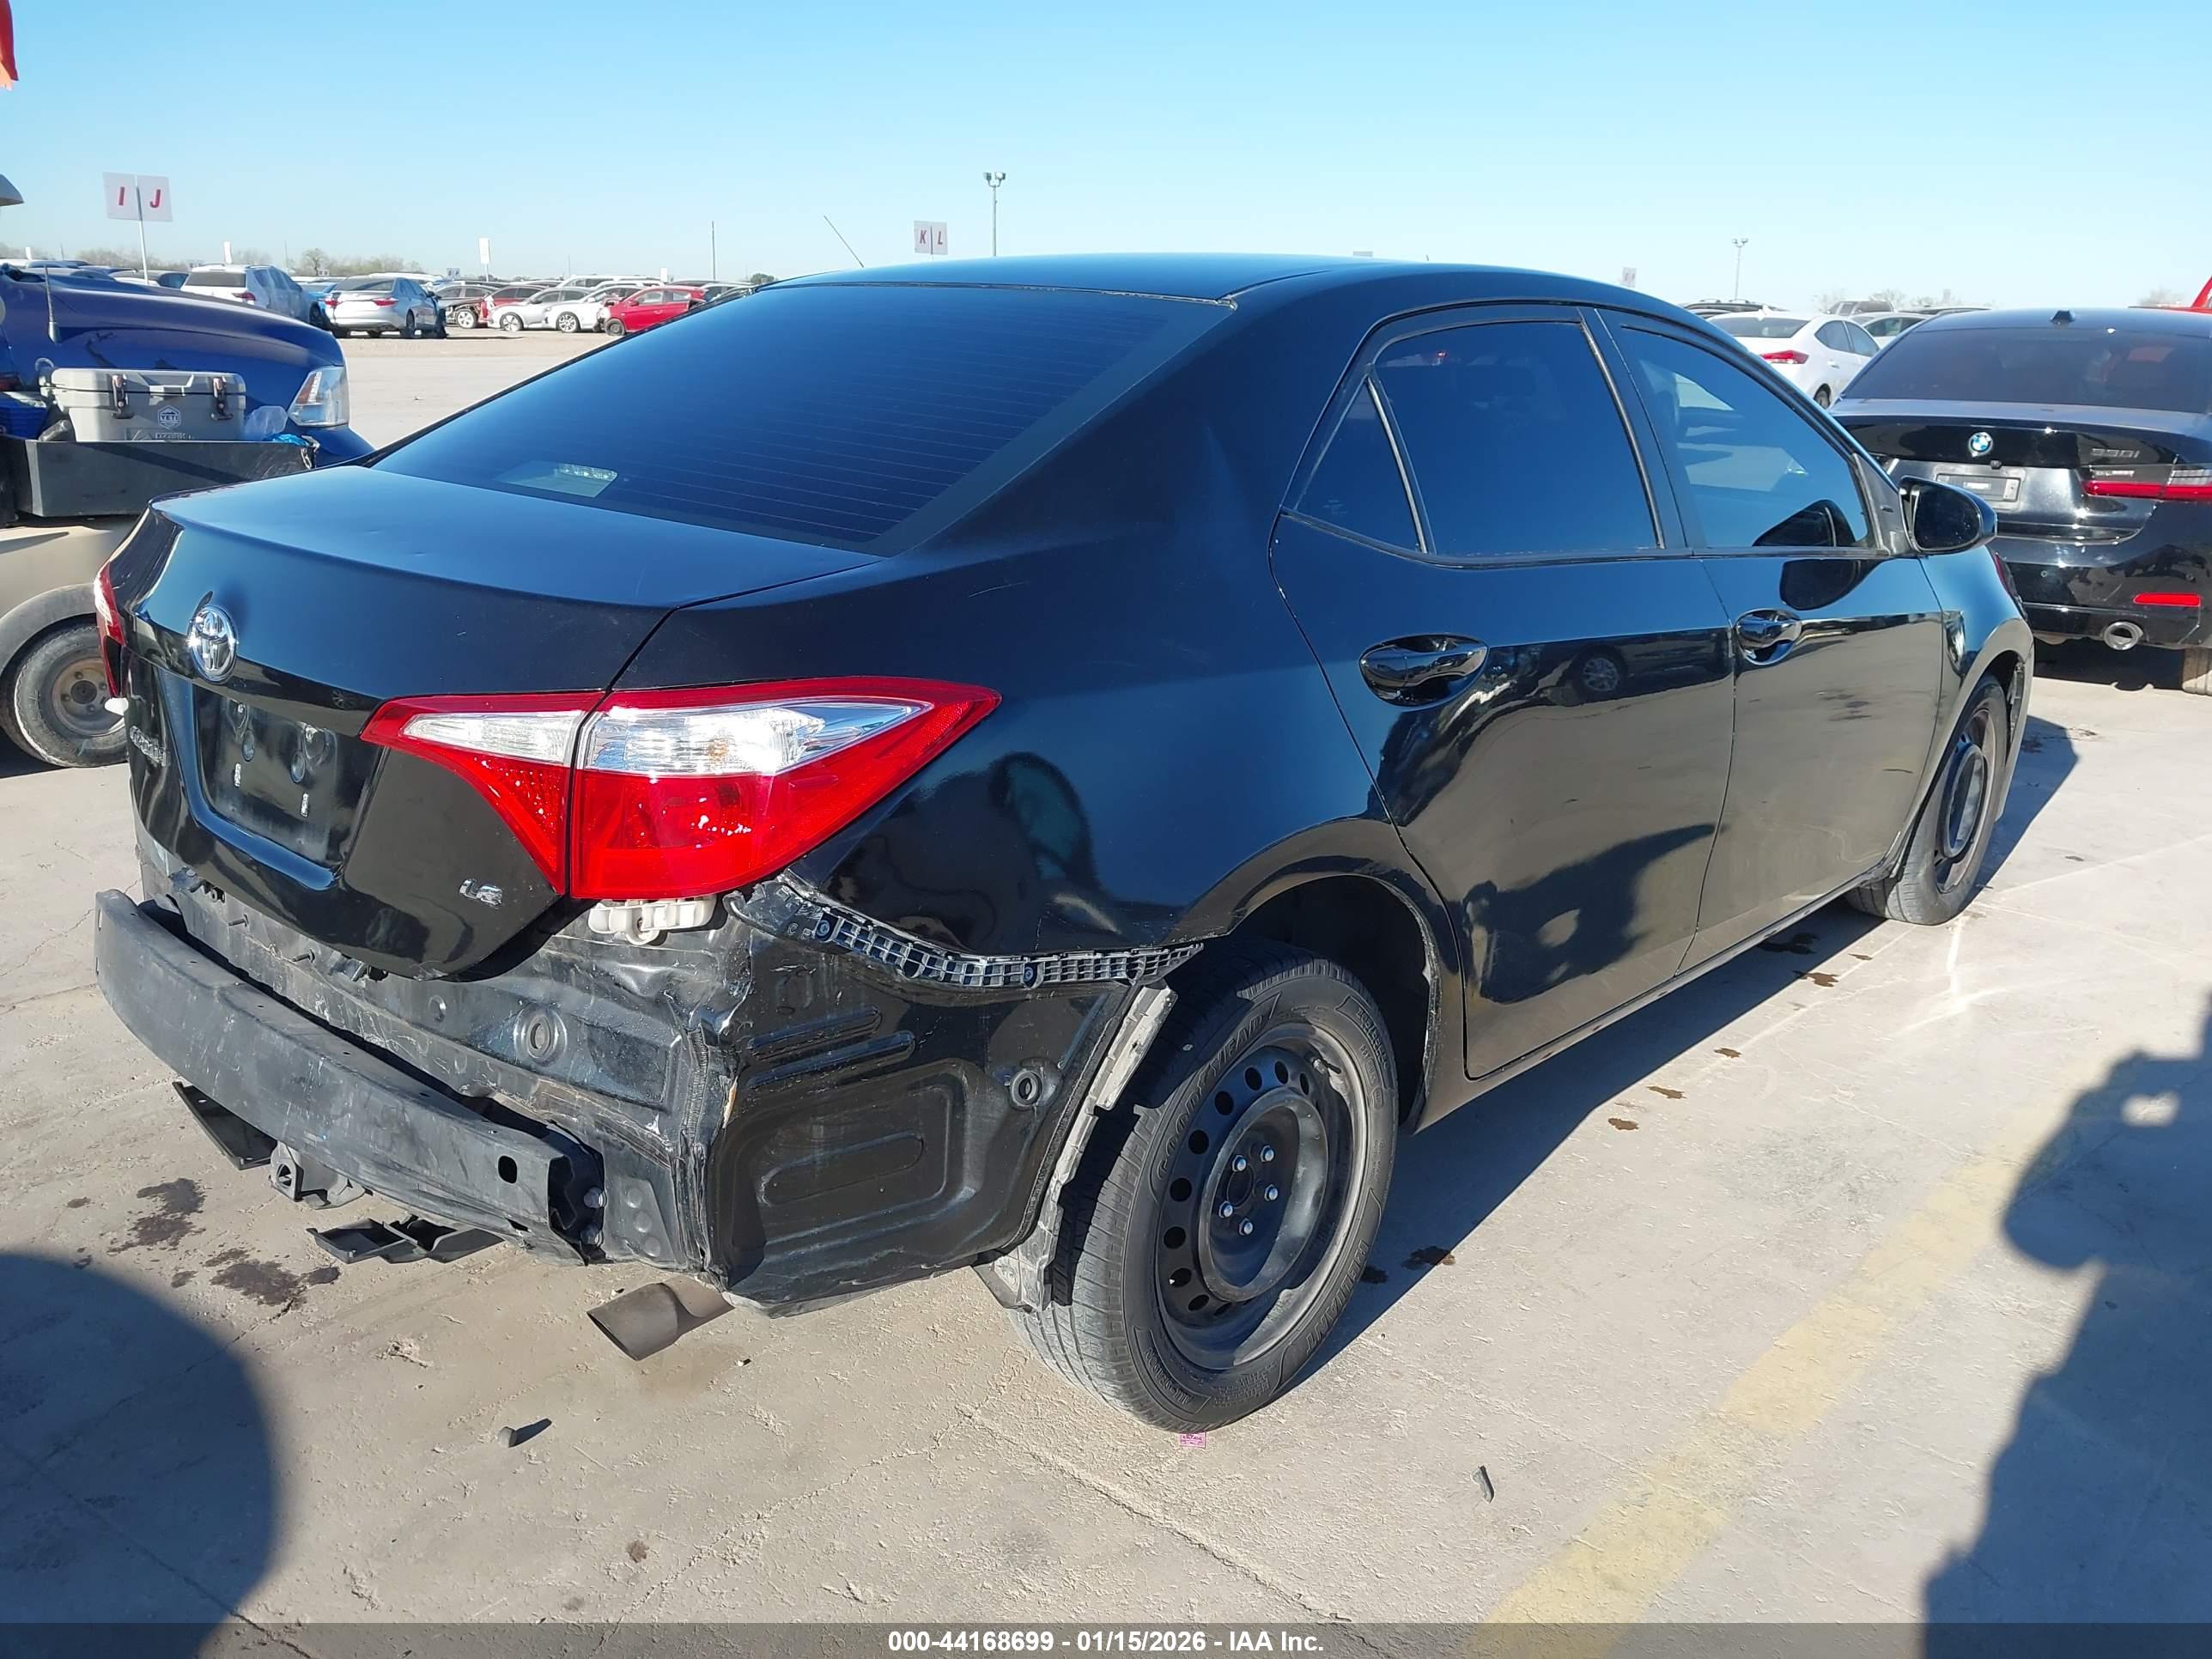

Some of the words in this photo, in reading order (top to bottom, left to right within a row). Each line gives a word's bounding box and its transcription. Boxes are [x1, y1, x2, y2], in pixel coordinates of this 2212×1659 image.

[118, 186, 125, 206] I
[149, 189, 161, 208] J
[919, 229, 927, 245] K
[937, 230, 944, 246] L
[1306, 1239, 1370, 1355] RELIANT
